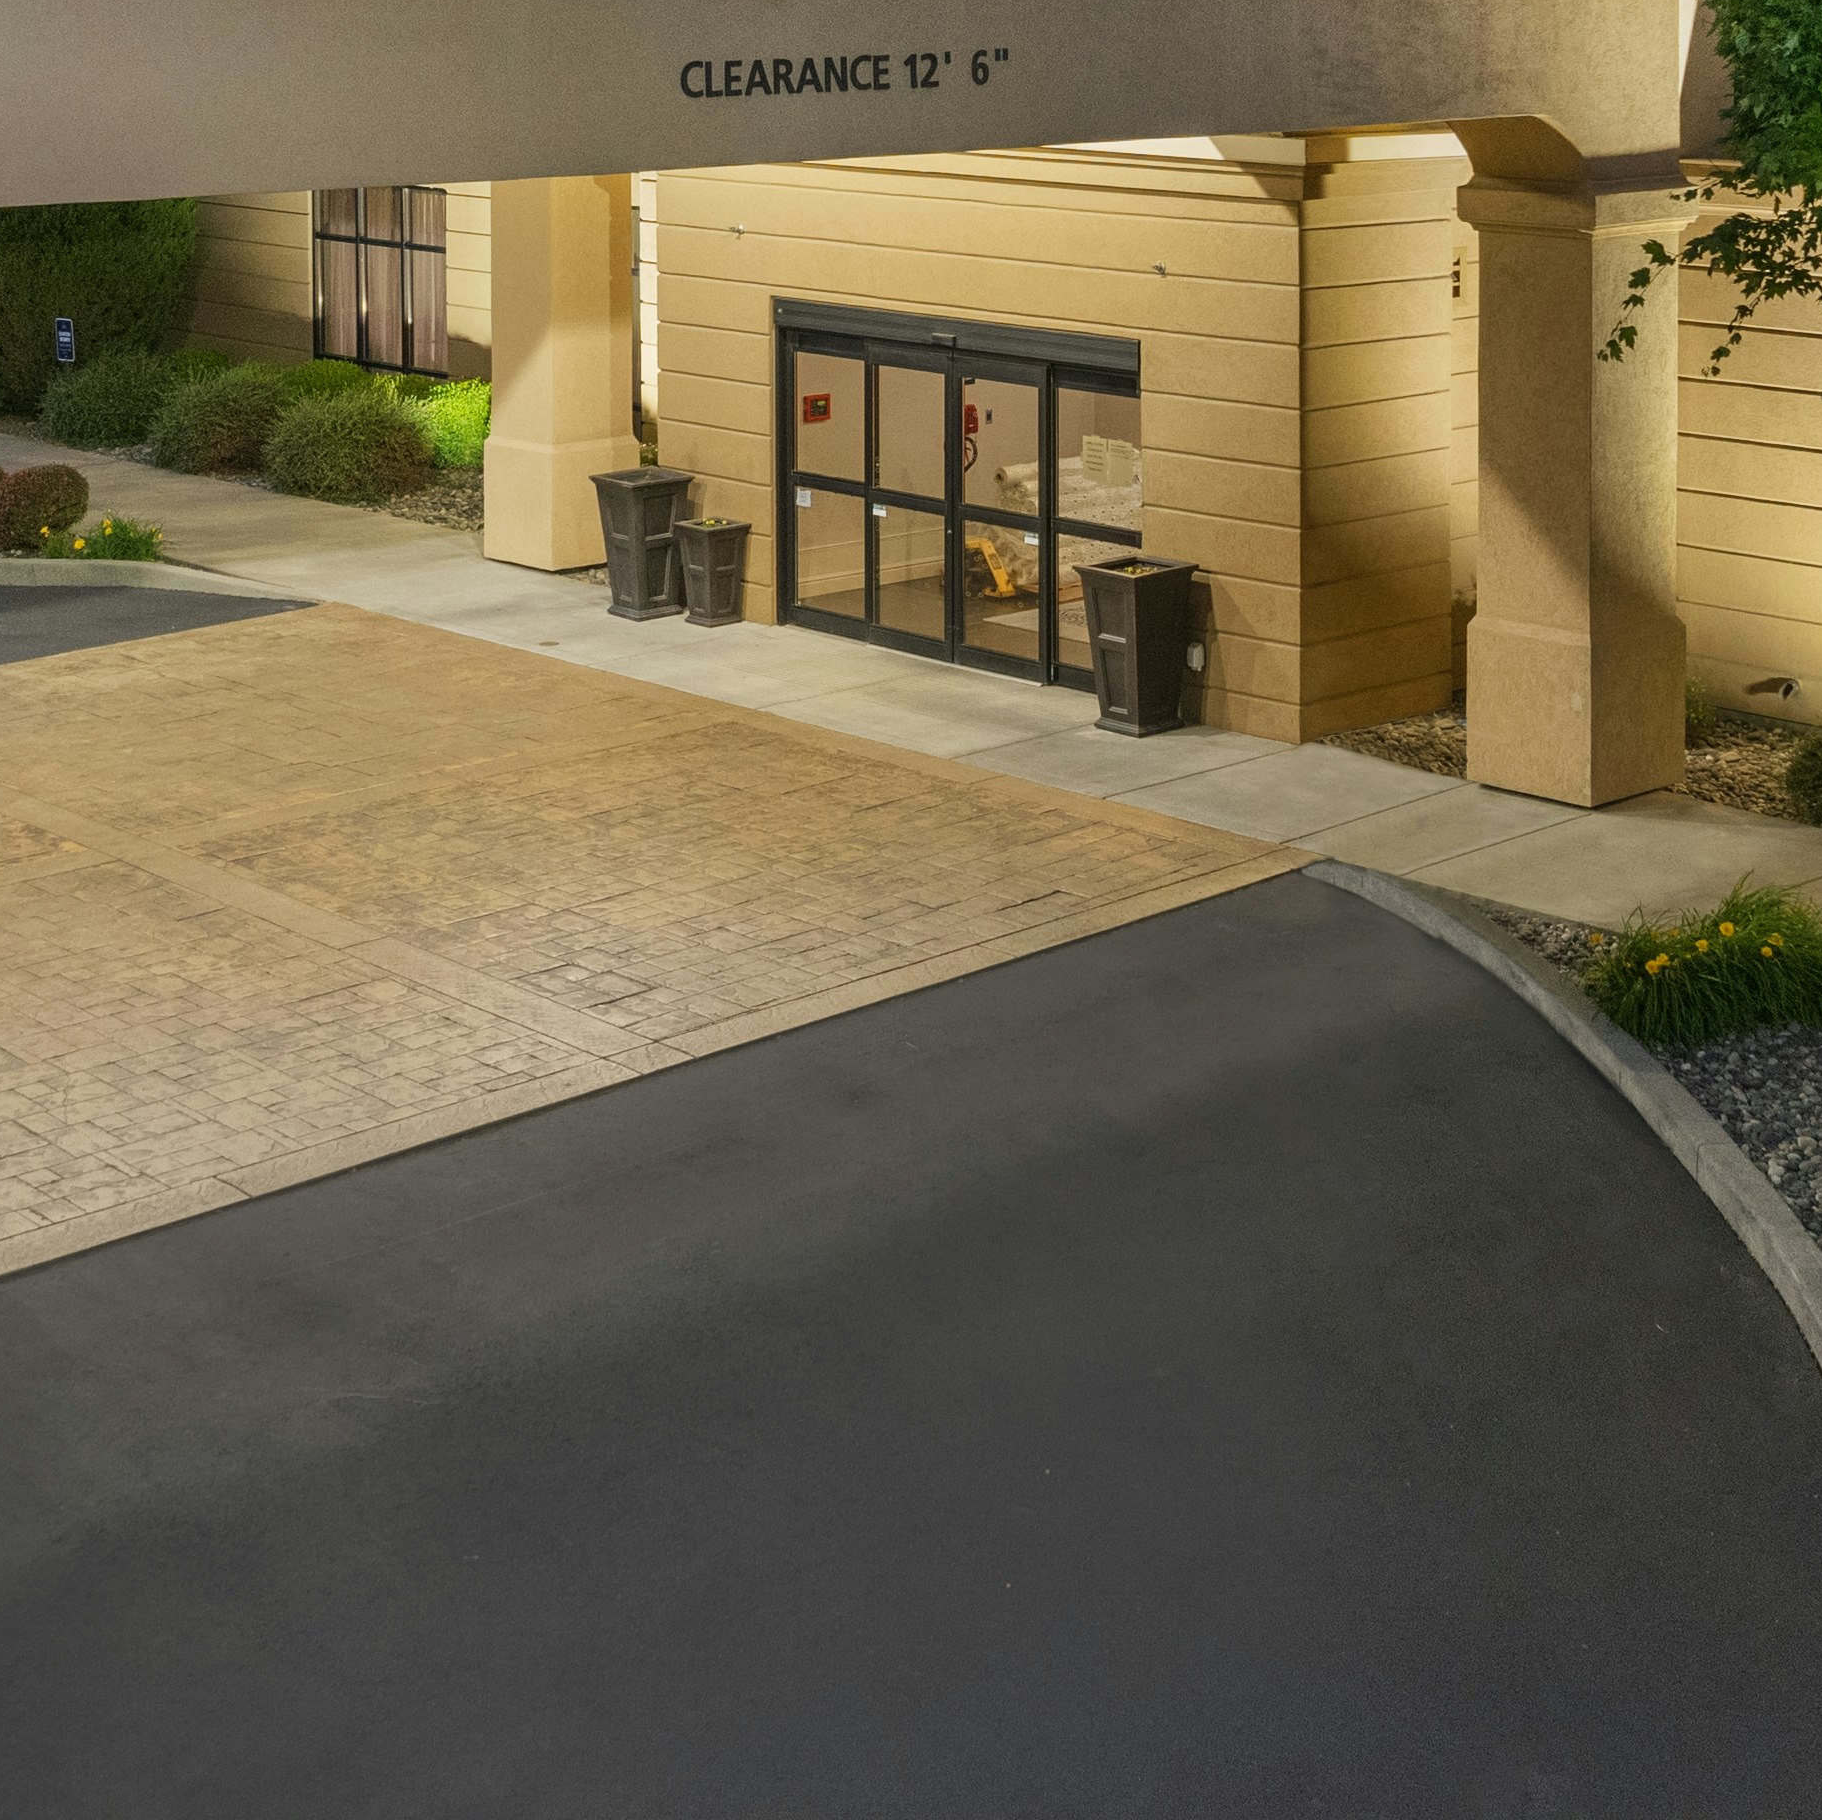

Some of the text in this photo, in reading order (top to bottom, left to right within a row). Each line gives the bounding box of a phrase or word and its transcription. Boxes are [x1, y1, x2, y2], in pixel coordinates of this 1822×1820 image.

[679, 47, 1010, 99] CLEARANCE 12' 6"
